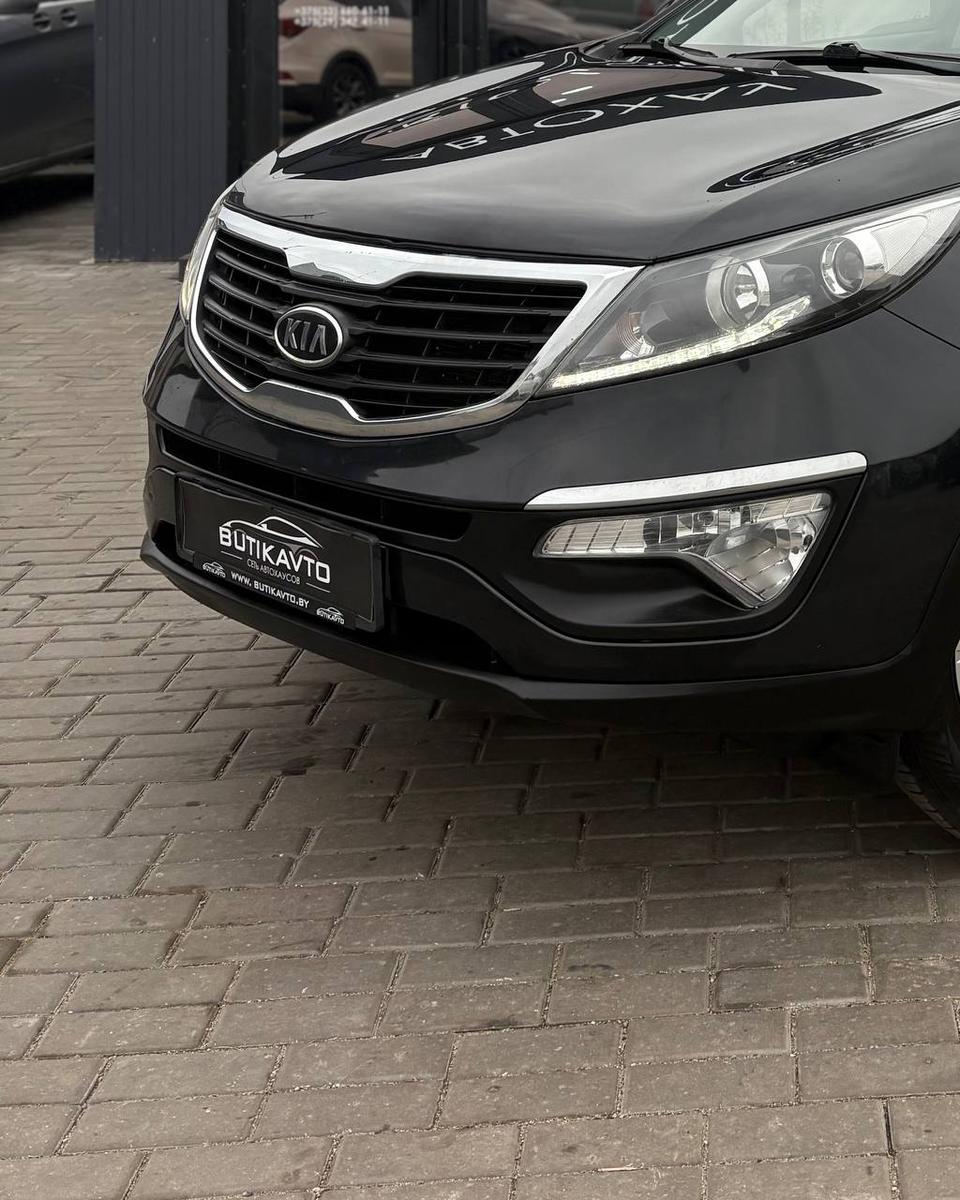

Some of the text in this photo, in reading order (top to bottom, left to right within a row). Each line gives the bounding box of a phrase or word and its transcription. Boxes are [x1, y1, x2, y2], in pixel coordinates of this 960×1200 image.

[283, 317, 327, 357] KIA
[219, 526, 331, 584] BUTIKAVTO
[260, 565, 301, 585] АВТОХАУСОВ
